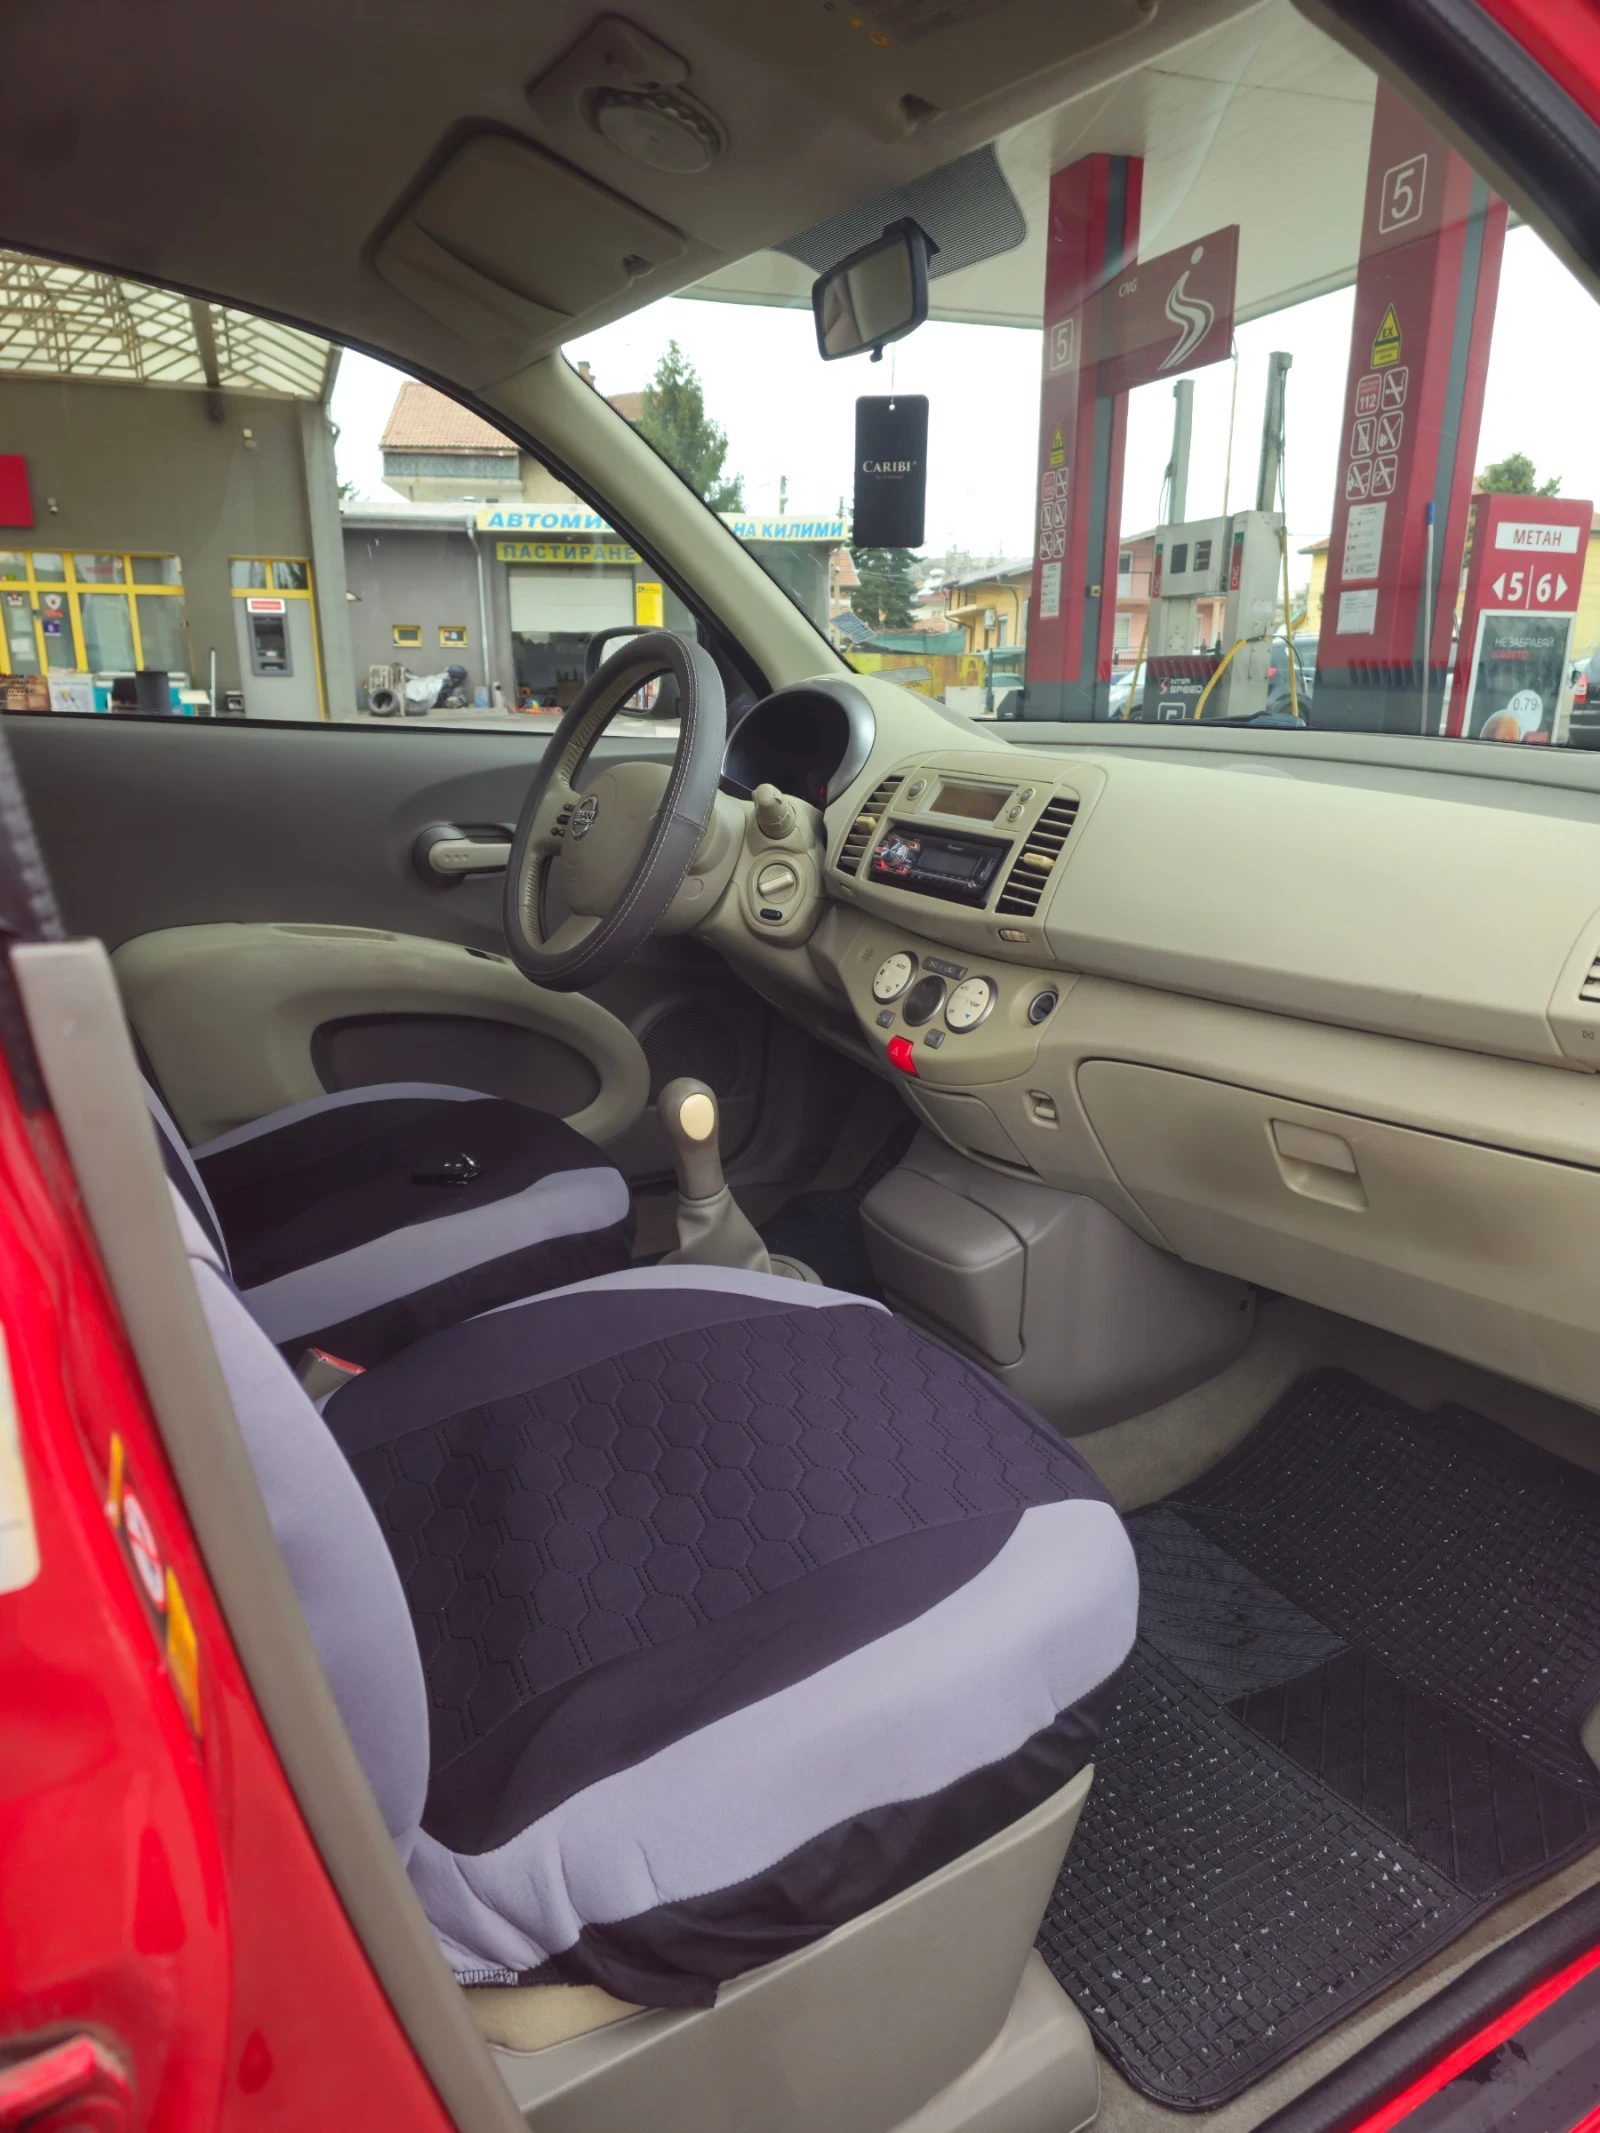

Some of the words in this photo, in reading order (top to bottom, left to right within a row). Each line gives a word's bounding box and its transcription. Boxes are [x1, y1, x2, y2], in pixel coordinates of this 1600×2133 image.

[1391, 168, 1414, 219] 5
[1118, 278, 1138, 297] CNG
[1382, 327, 1394, 338] EX
[1056, 327, 1068, 362] 5
[1360, 394, 1376, 410] 112
[863, 460, 910, 473] CARIBI
[487, 511, 612, 529] АВТОМИ
[733, 522, 756, 537] НА
[761, 521, 844, 538] КИЛИМИ
[1513, 528, 1562, 547] МЕТАН
[503, 543, 635, 561] ПАСТИРАНЕ
[1231, 565, 1240, 587] CNG
[1507, 571, 1524, 602] 5
[1536, 573, 1552, 603] 6
[1495, 637, 1507, 648] НЕ
[1508, 636, 1554, 648] ЗАБРАВЯЙ
[1170, 685, 1203, 694] SPEED
[1513, 697, 1538, 711] 0.79
